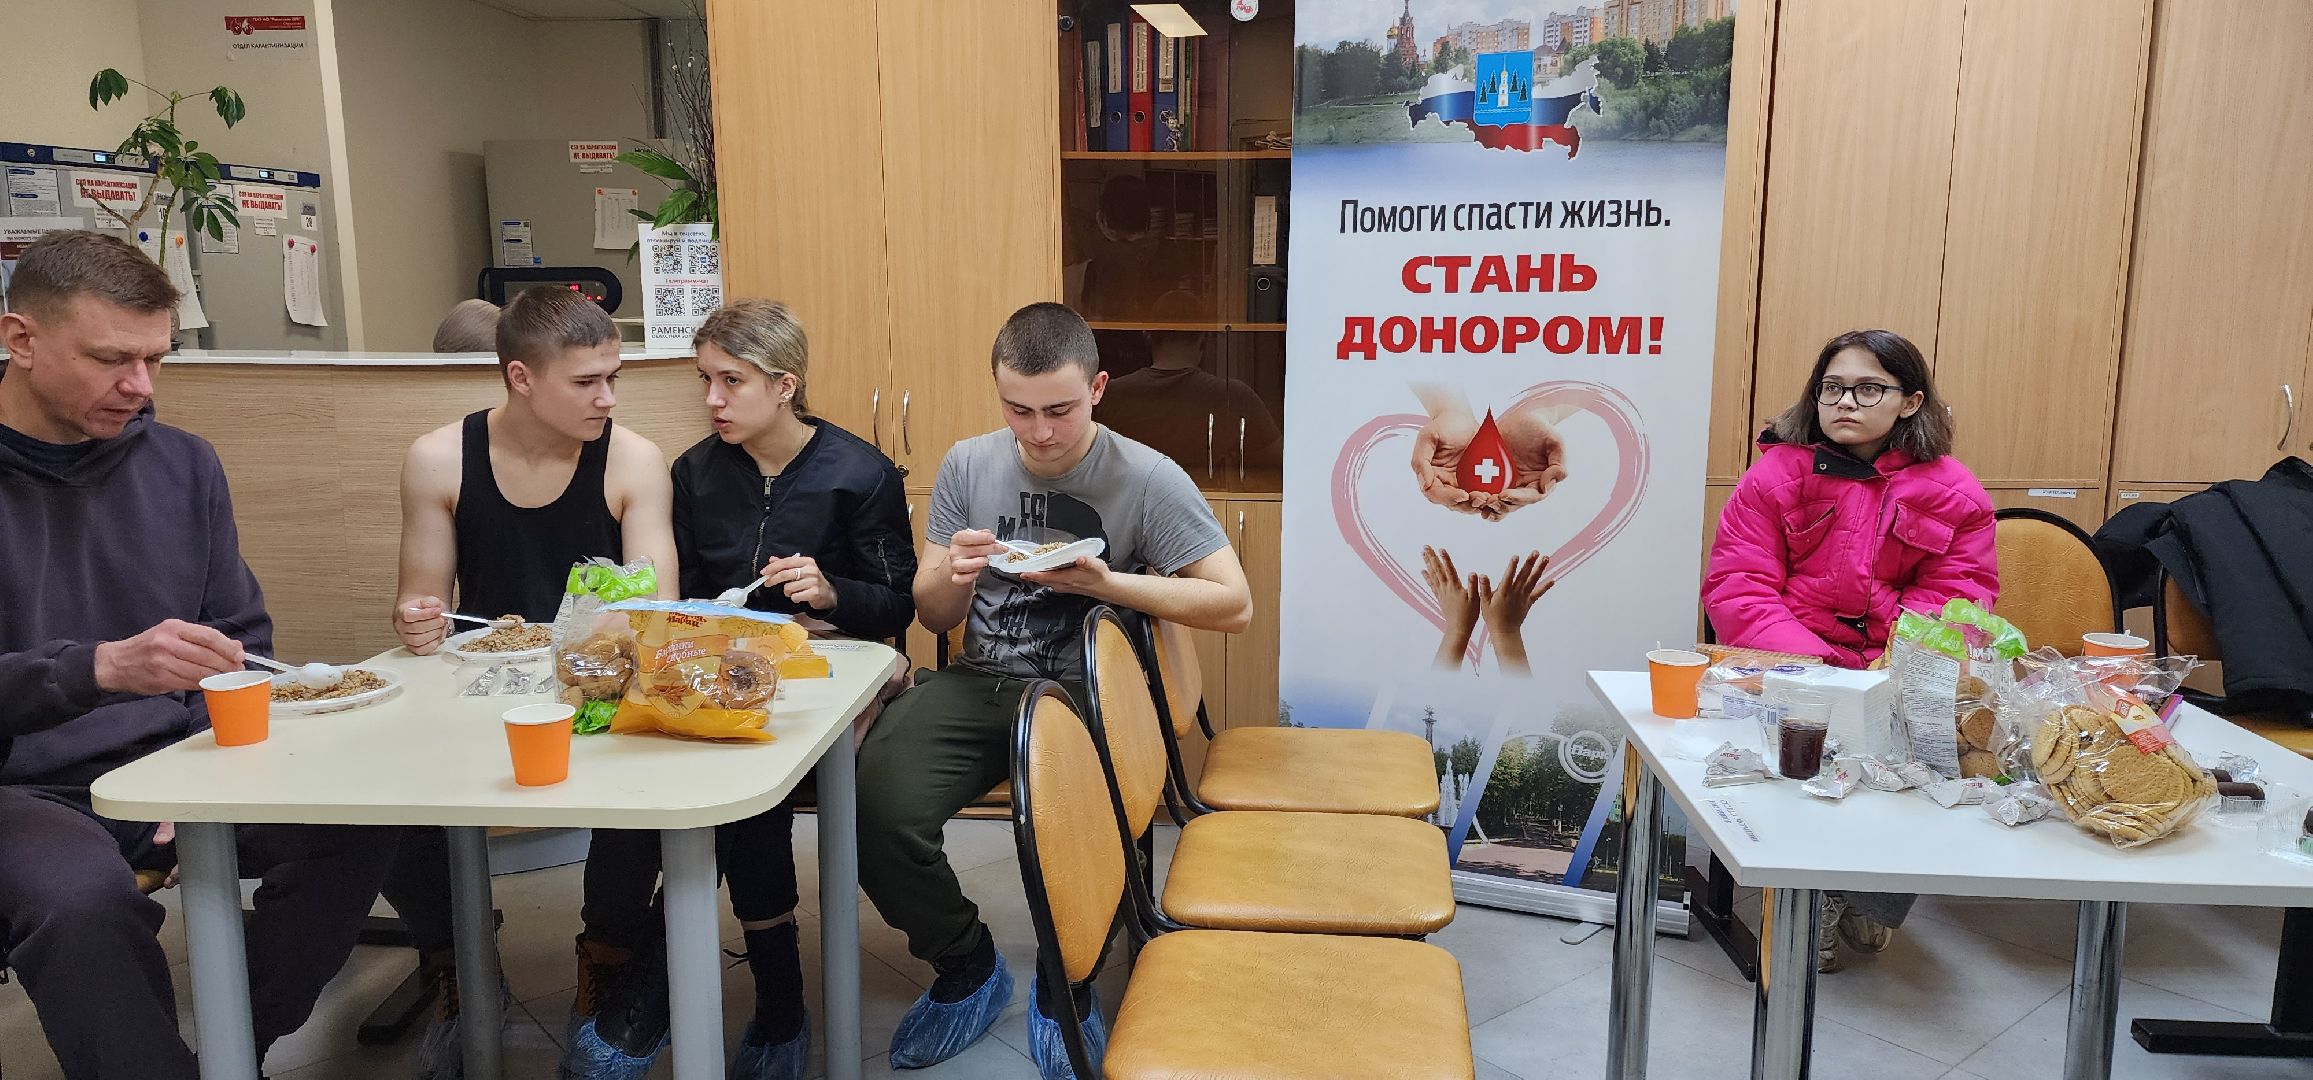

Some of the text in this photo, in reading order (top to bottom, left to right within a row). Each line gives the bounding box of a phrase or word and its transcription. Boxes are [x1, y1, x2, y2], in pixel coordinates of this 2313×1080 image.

[91, 189, 136, 201] ВЫДАВАТЬ!
[242, 199, 283, 210] НЕ ВЫДАВАТЬ!
[1340, 199, 1672, 234] Помоги спасти жизнь.
[1401, 254, 1597, 294] СТАНЬ
[651, 326, 697, 334] РАМЕНСК
[1336, 316, 1664, 360] ДОНОРОМ!
